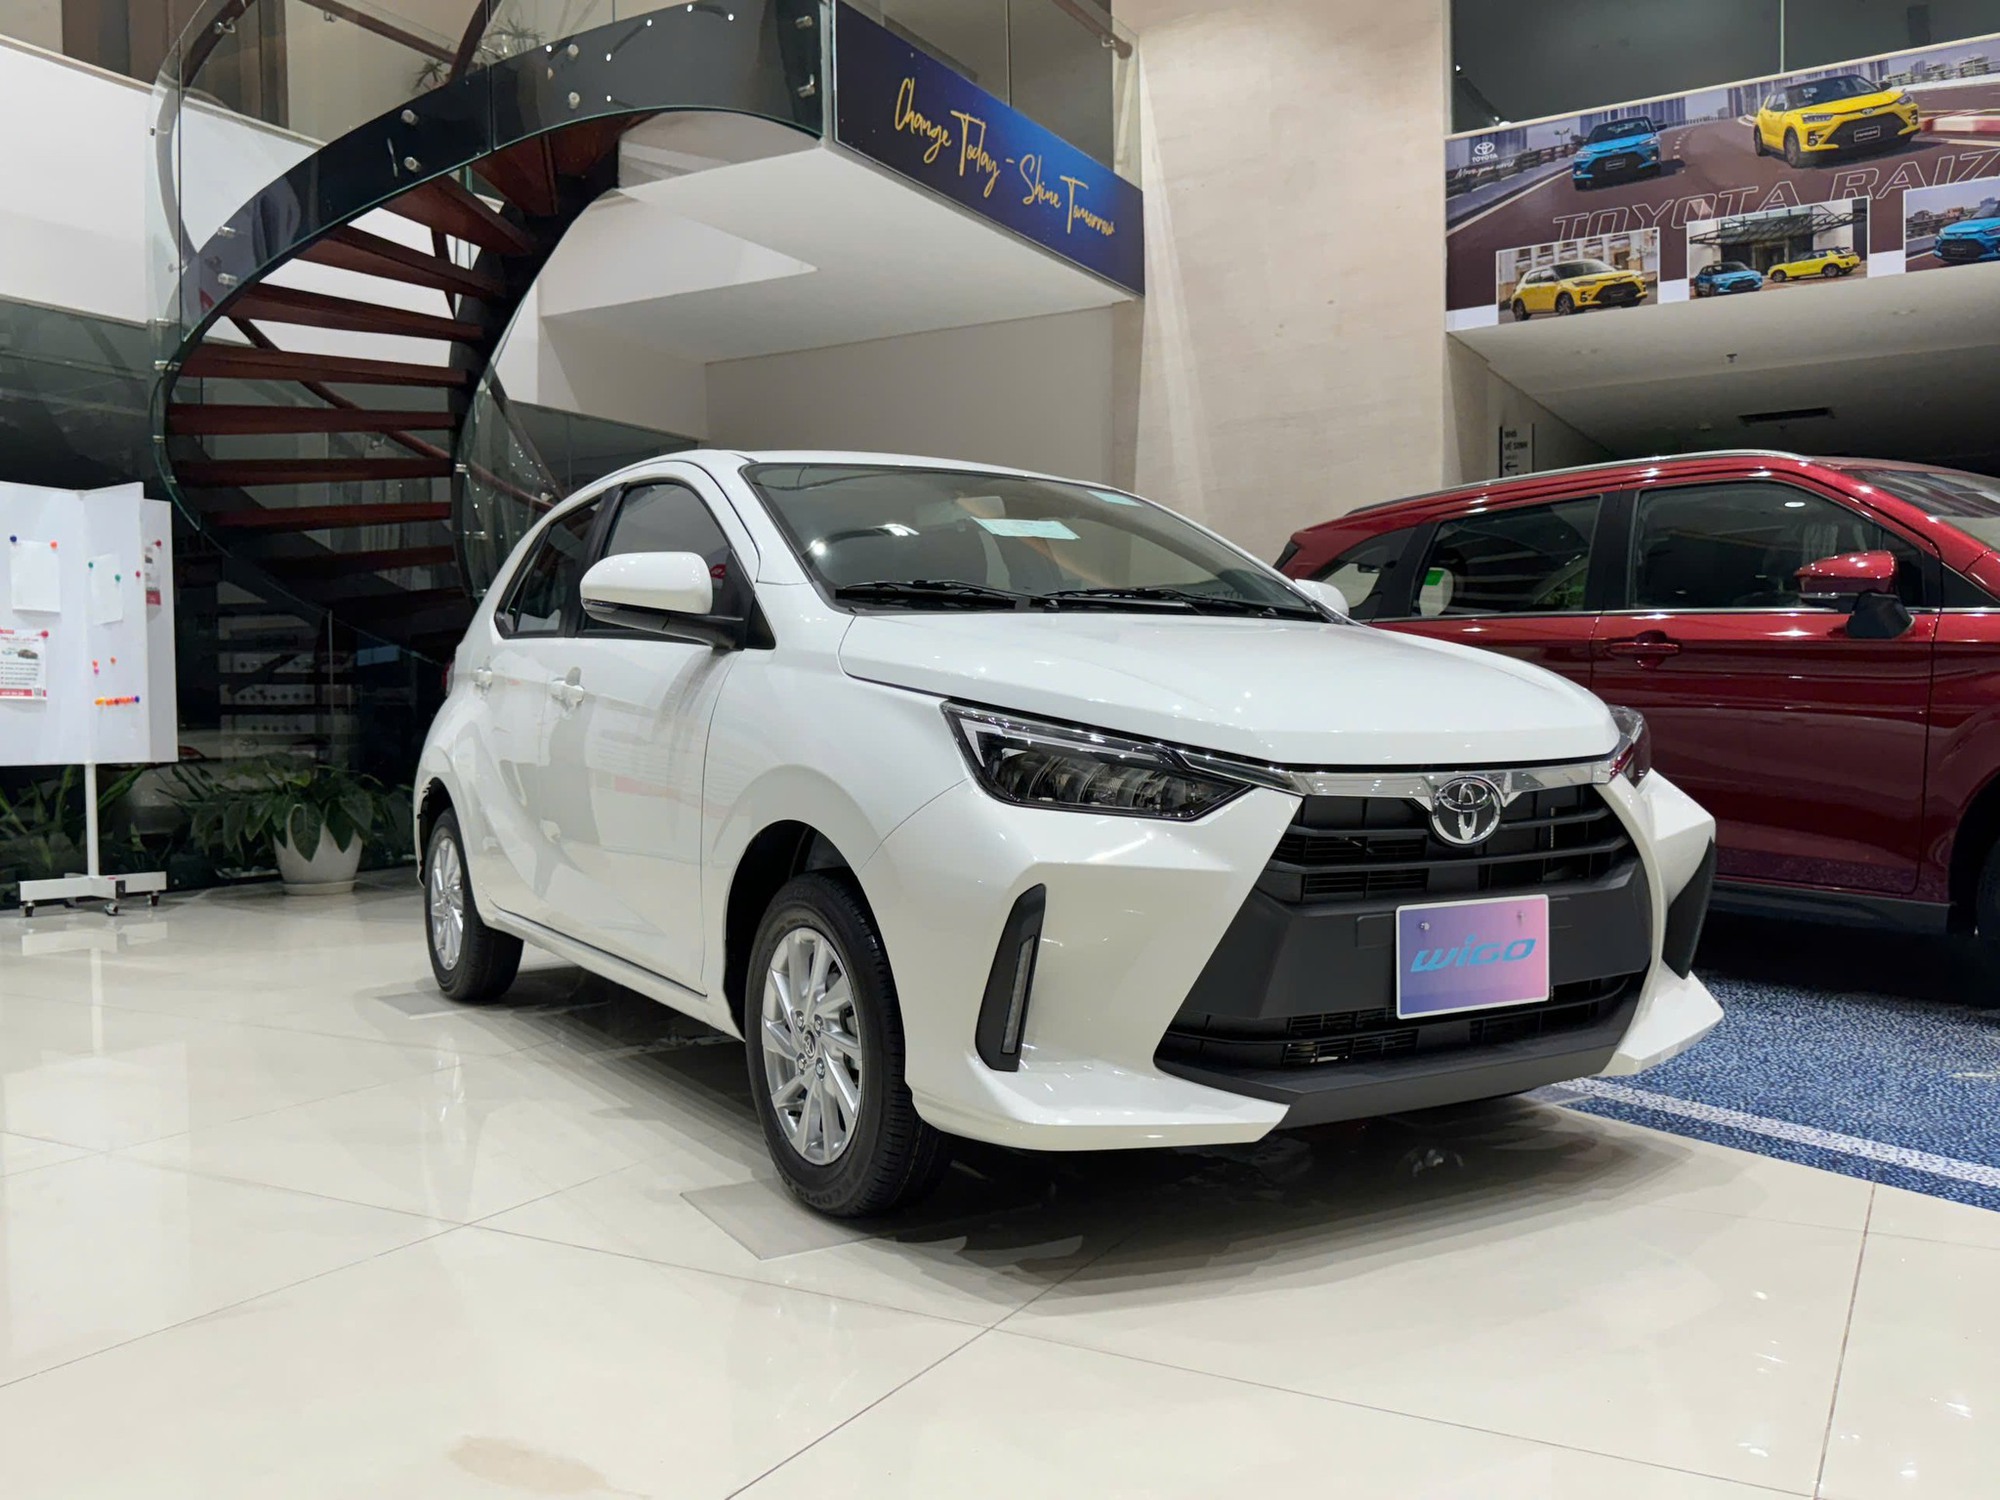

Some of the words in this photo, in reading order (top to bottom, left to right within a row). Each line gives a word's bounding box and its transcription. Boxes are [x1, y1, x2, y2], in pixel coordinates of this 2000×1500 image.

[894, 77, 951, 164] Change
[950, 110, 1000, 198] Today
[1019, 154, 1061, 205] Shine
[1471, 153, 1498, 163] TOYOTA
[1553, 181, 1801, 243] TOYOTA
